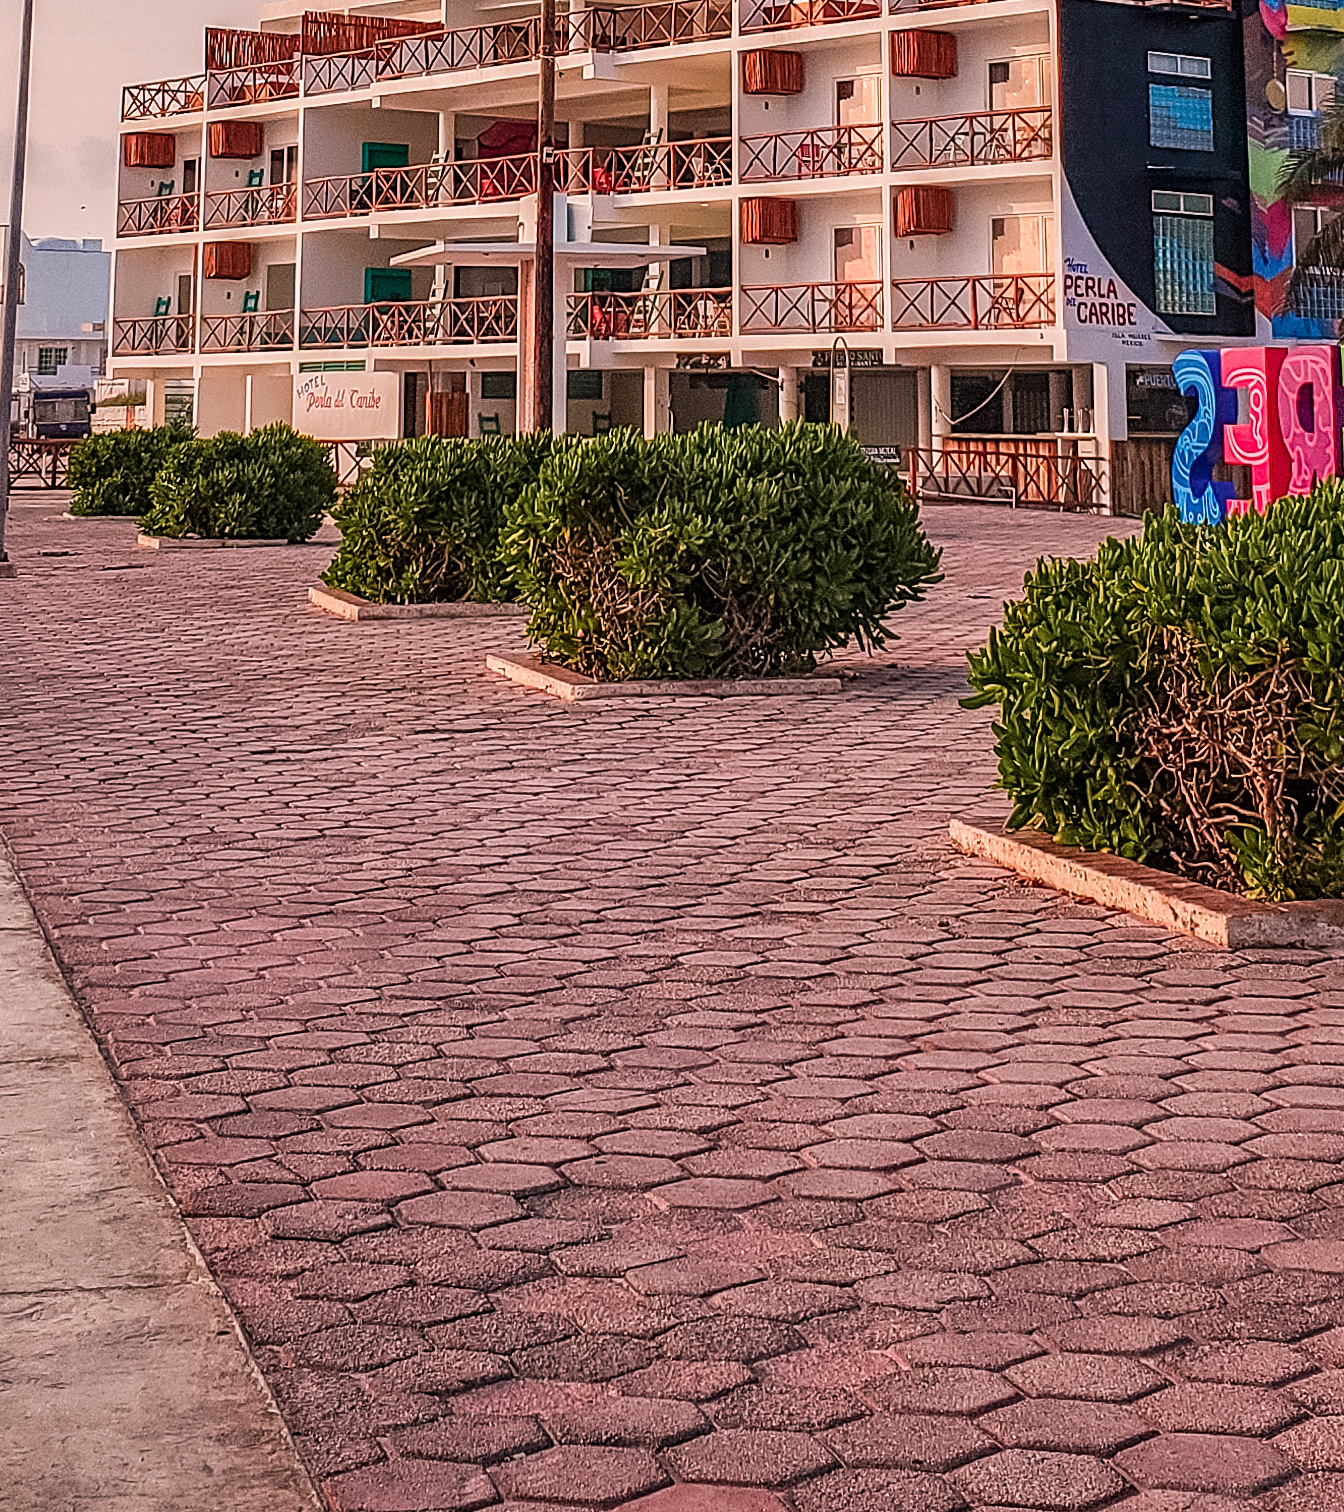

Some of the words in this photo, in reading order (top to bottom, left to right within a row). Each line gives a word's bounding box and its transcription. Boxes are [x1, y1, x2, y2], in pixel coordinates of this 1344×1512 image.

[1063, 274, 1118, 300] PERLA
[1077, 301, 1137, 326] CARIBE
[296, 374, 326, 399] HOTEL
[306, 386, 332, 412] Perla
[334, 389, 346, 408] del
[349, 388, 381, 409] Caribe
